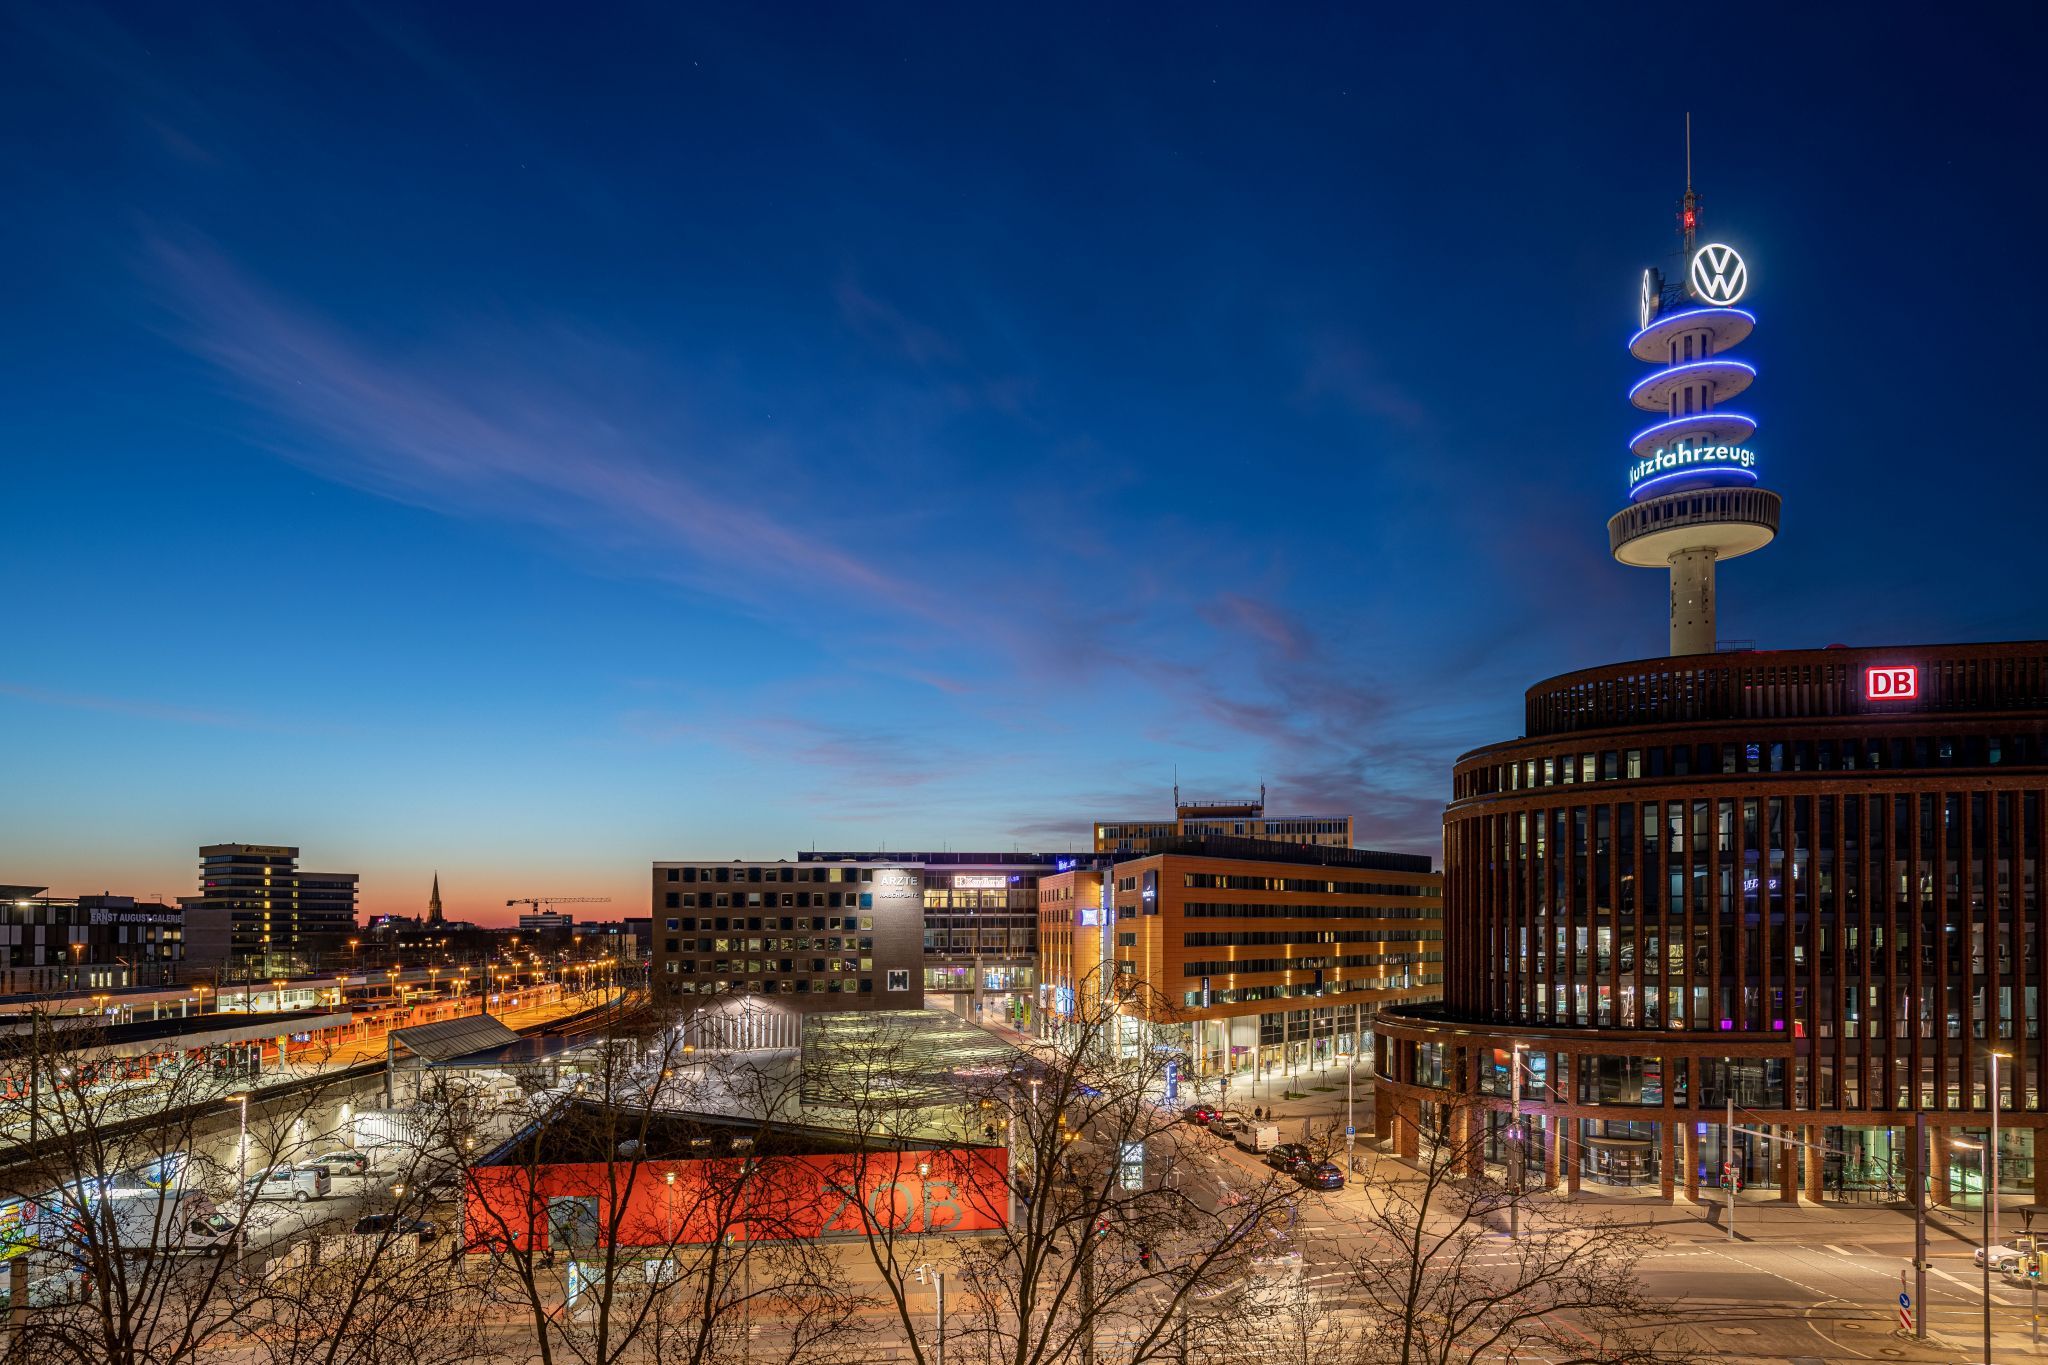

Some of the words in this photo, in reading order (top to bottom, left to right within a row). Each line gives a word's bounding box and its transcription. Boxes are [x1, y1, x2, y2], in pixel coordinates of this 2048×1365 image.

[1873, 671, 1912, 695] DB
[91, 912, 118, 922] ERNST
[120, 913, 150, 923] AUGUST
[152, 914, 182, 924] GALERIE
[821, 1180, 962, 1235] ZOB
